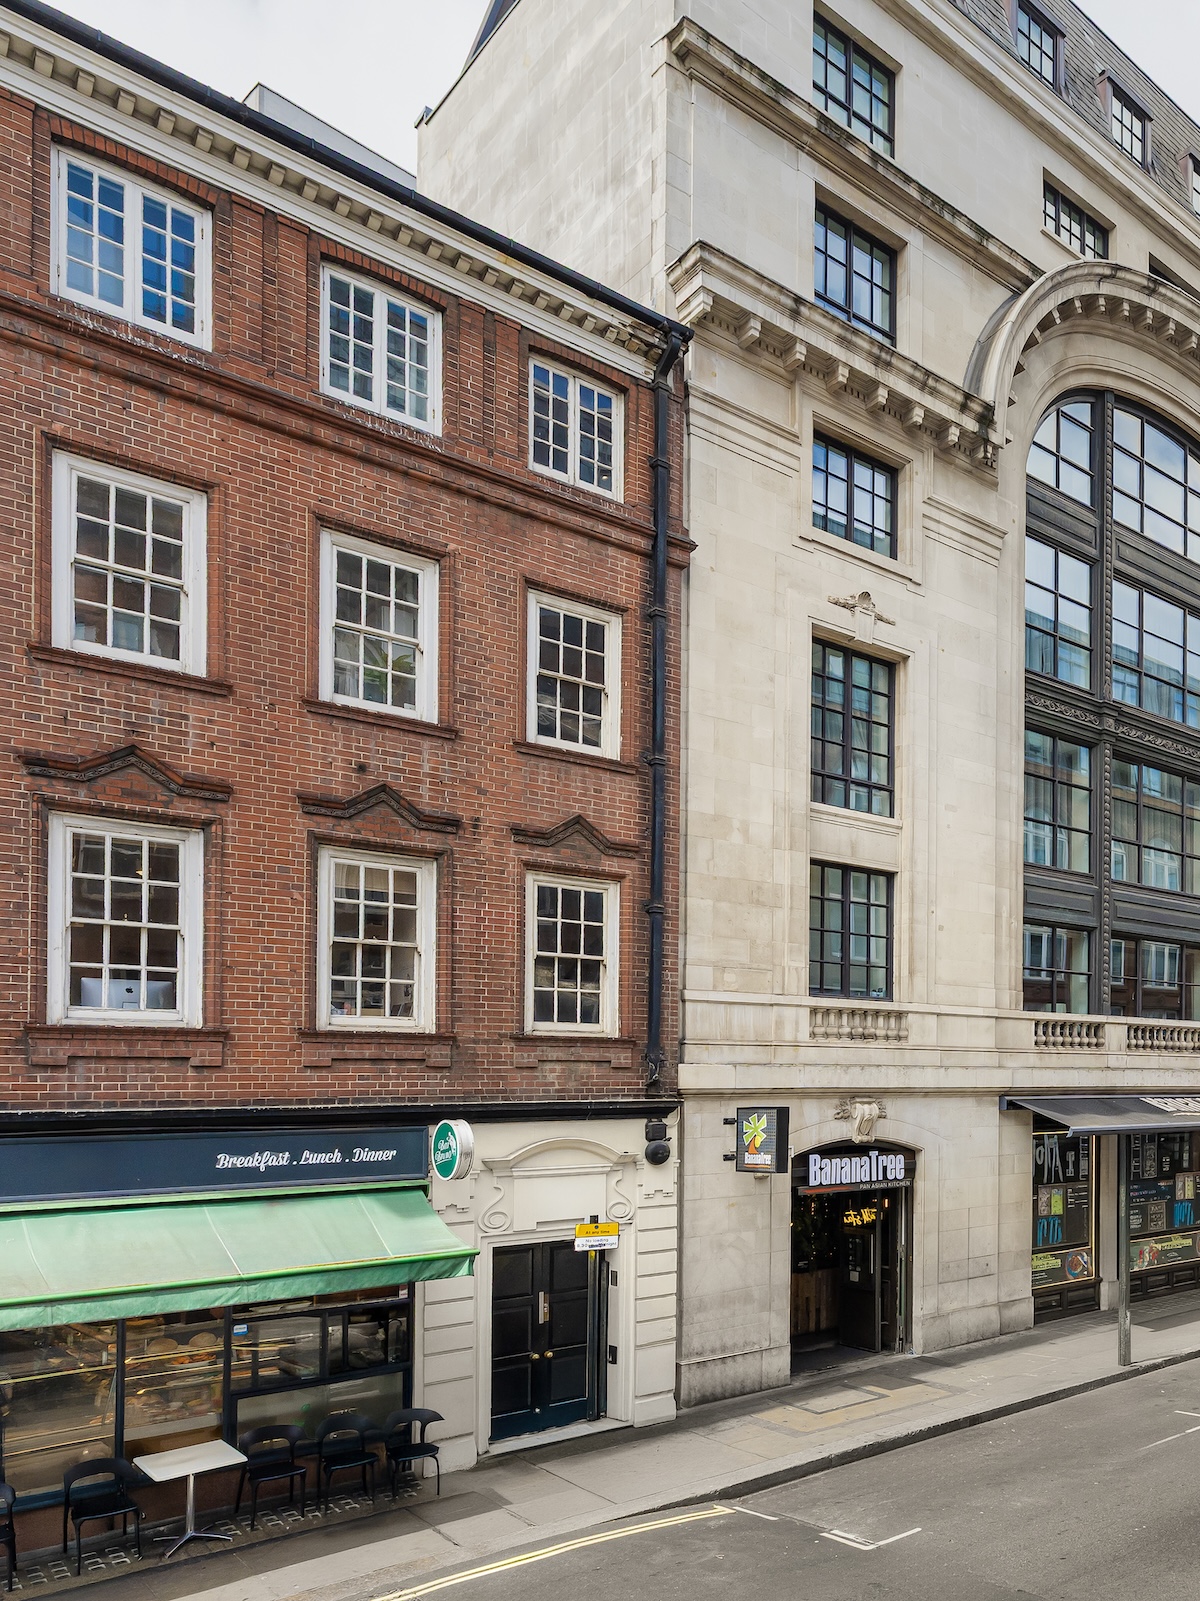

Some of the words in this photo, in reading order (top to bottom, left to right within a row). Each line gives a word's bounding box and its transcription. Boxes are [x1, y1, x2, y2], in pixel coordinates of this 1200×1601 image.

[216, 1151, 290, 1172] Breakfast
[300, 1148, 342, 1165] Lunch
[352, 1147, 397, 1163] Dinner
[808, 1151, 905, 1187] BananaTree
[888, 1180, 911, 1188] KITCHEN
